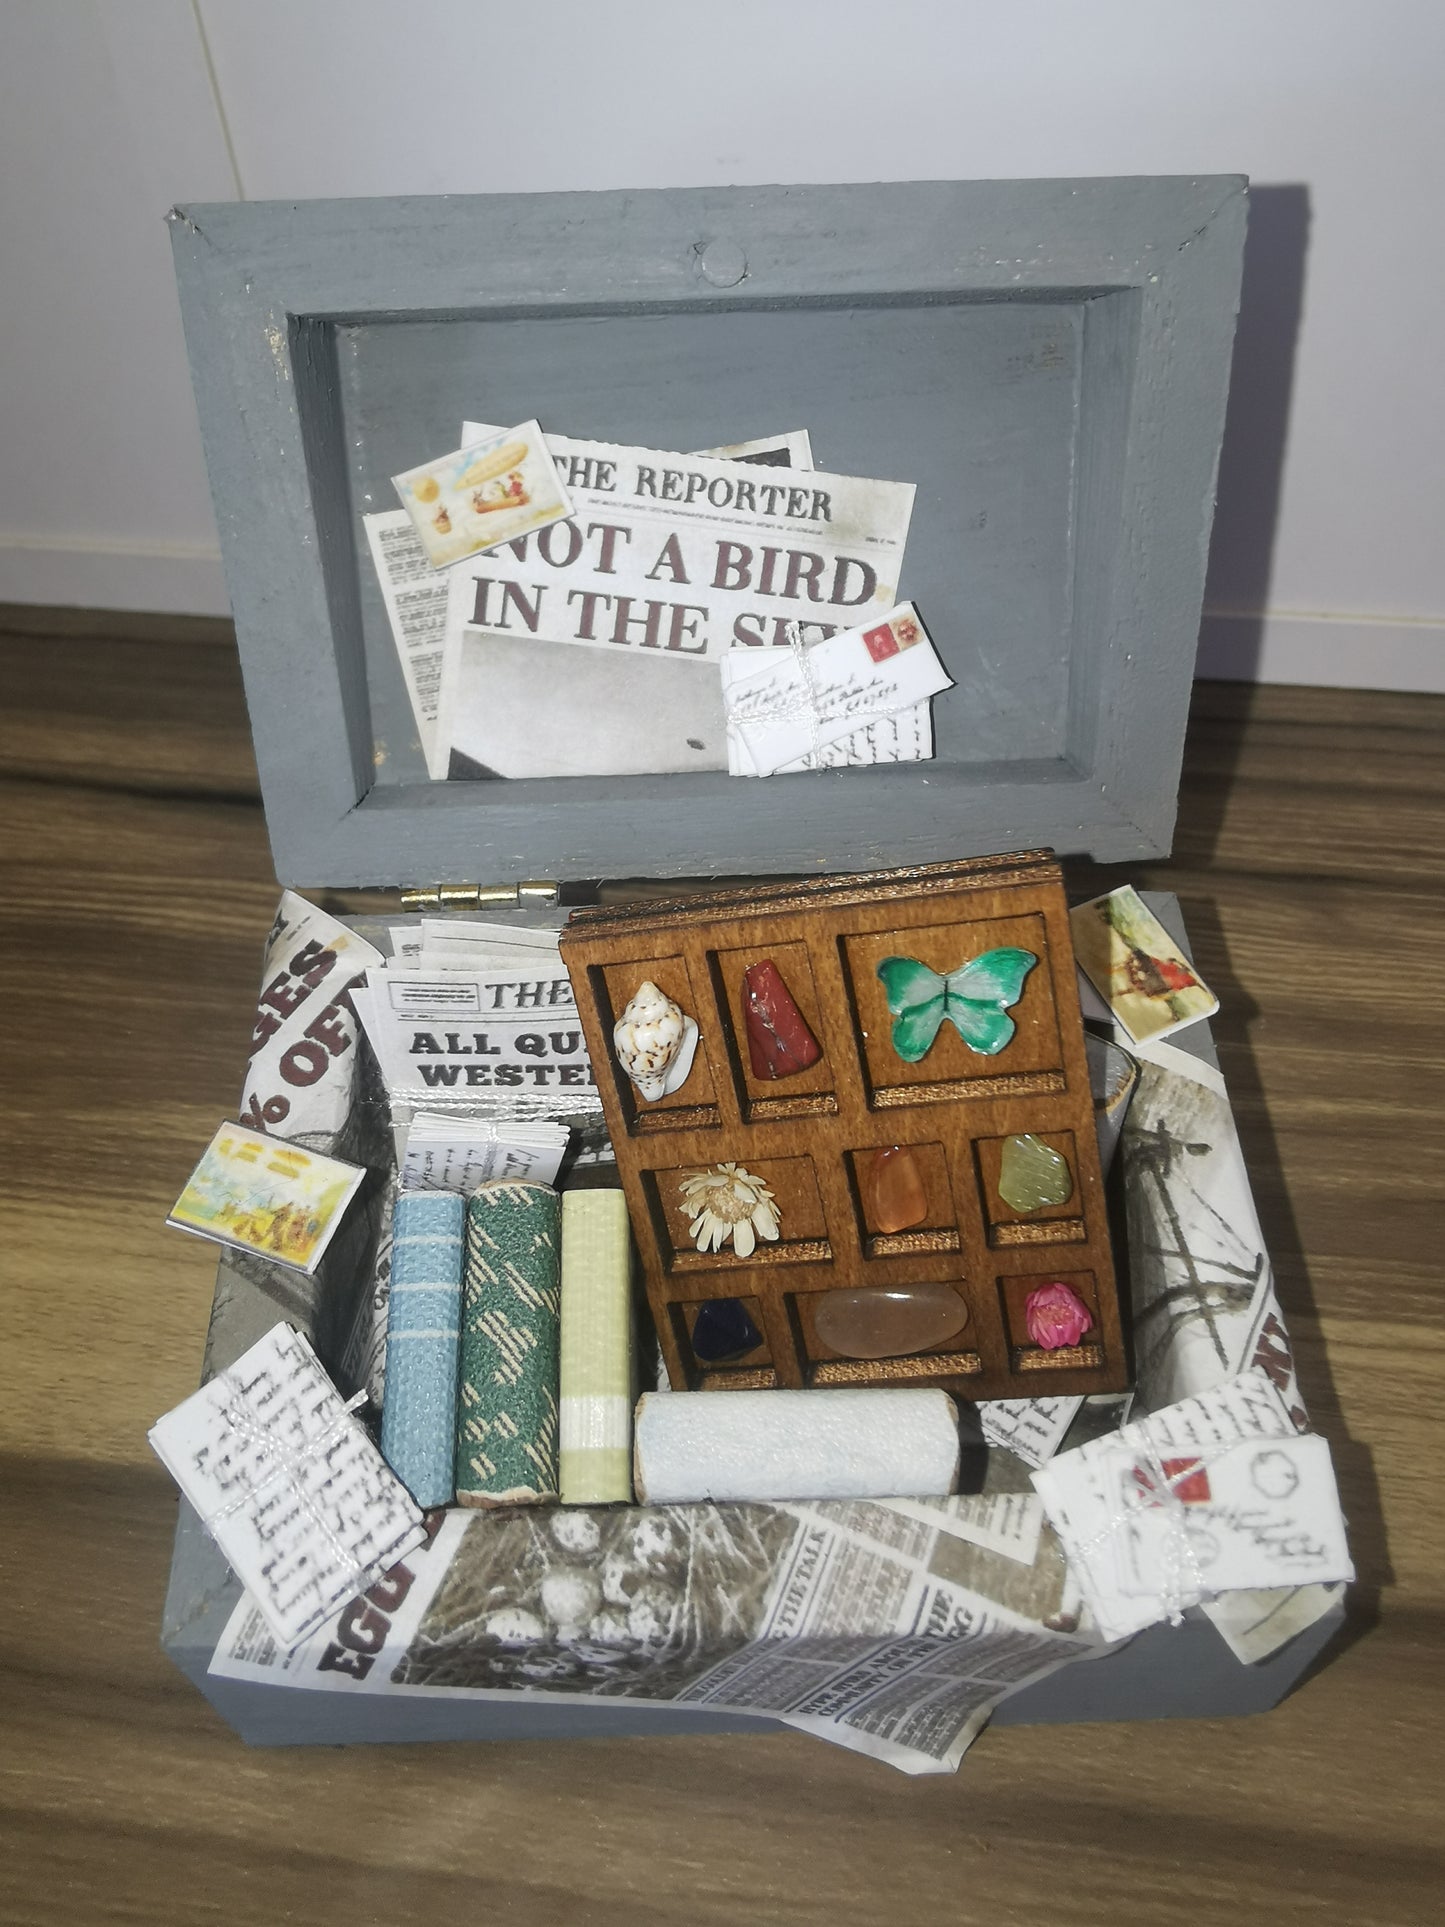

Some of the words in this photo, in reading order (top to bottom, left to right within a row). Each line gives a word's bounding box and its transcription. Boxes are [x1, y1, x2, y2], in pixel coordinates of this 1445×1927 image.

[552, 455, 618, 492] THE
[634, 463, 834, 523] REPORTER
[644, 532, 692, 585] A
[709, 539, 878, 606] BIRD
[467, 575, 550, 633] IN
[566, 588, 710, 655] THE
[484, 978, 574, 1009] THE
[408, 1031, 502, 1055] ALL
[513, 1030, 589, 1058] QU
